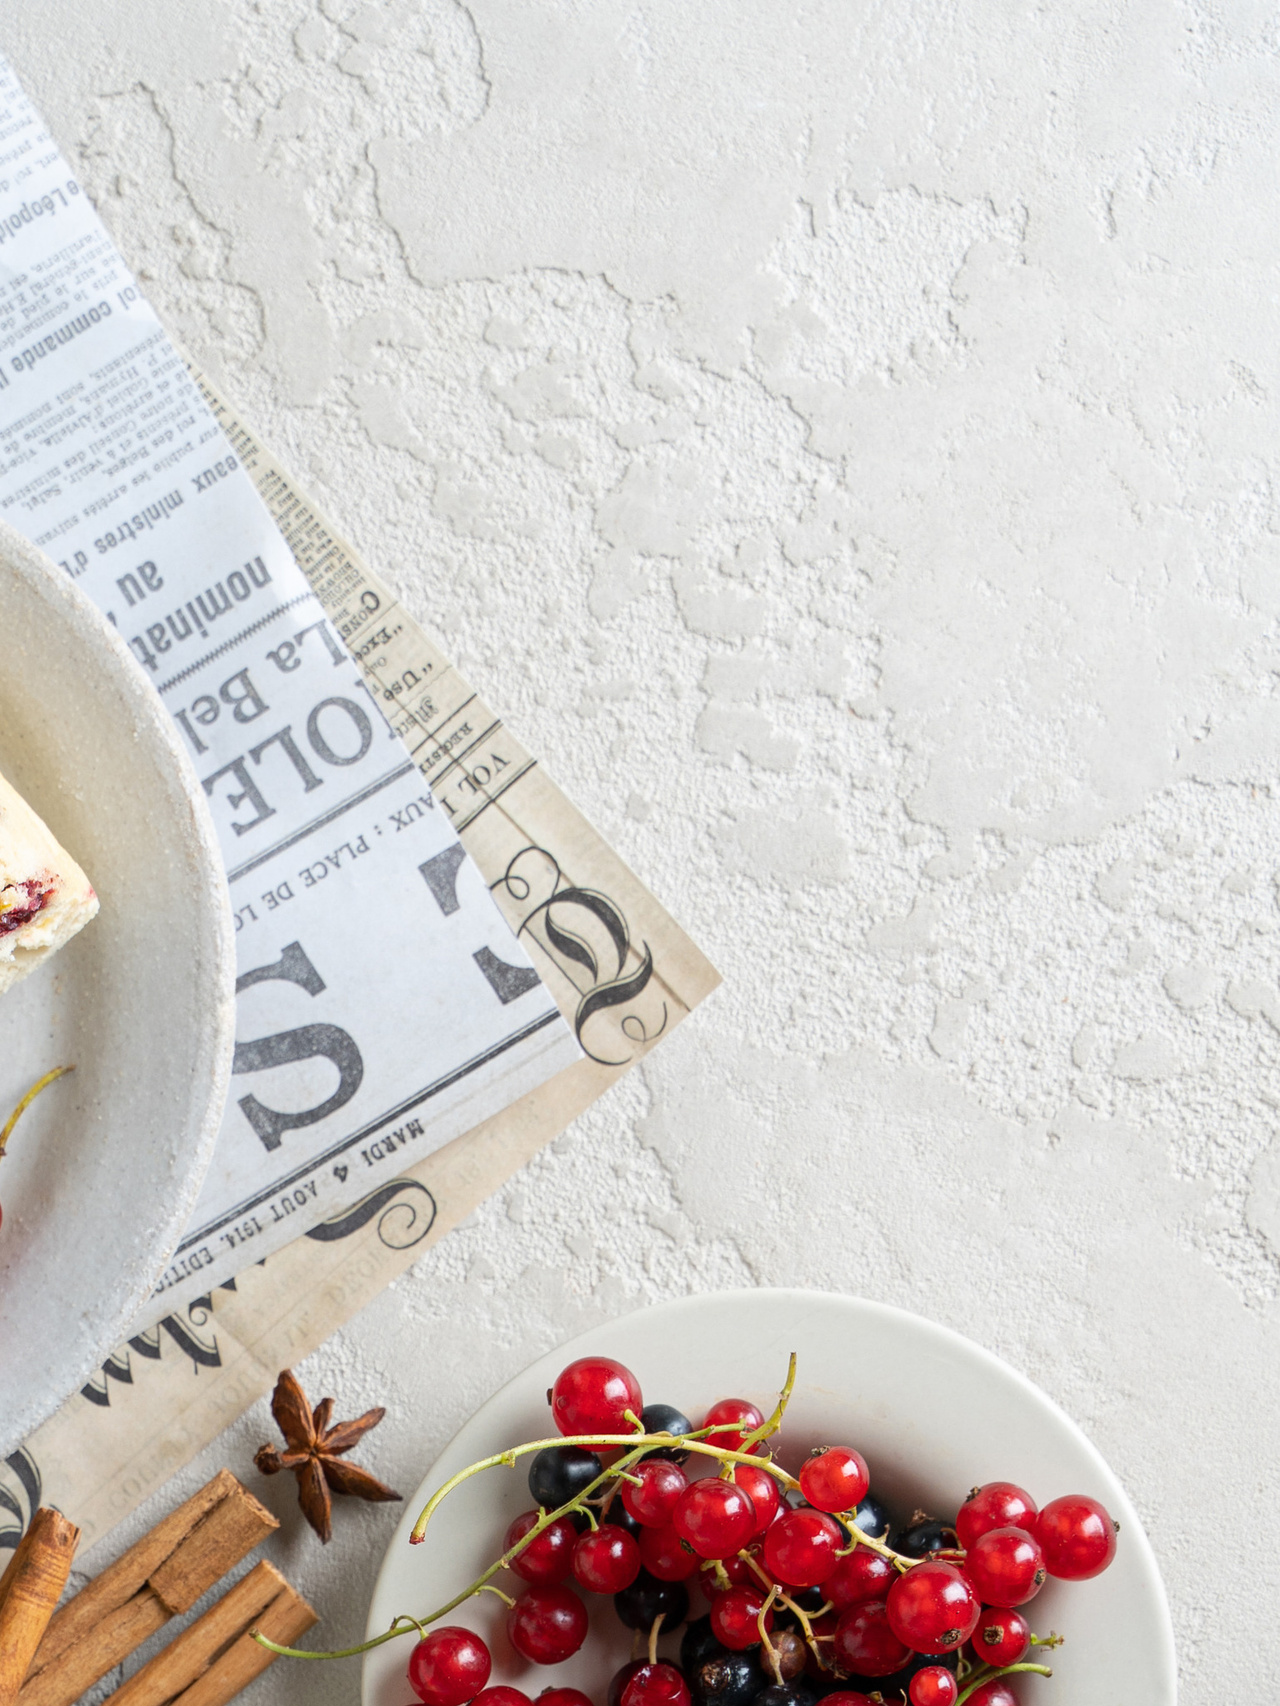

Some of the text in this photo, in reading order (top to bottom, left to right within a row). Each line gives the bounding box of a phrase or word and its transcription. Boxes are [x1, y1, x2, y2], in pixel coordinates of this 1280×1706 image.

[8, 299, 115, 377] commande
[92, 487, 187, 562] ministres
[114, 557, 167, 609] au
[124, 554, 278, 677] nominat
[263, 615, 349, 699] La
[456, 747, 511, 801] VOL
[296, 831, 372, 891] PLACE
[258, 879, 296, 914] DE
[357, 1115, 428, 1171] MARDI
[329, 1161, 354, 1188] 4
[265, 1179, 324, 1228] AOUT
